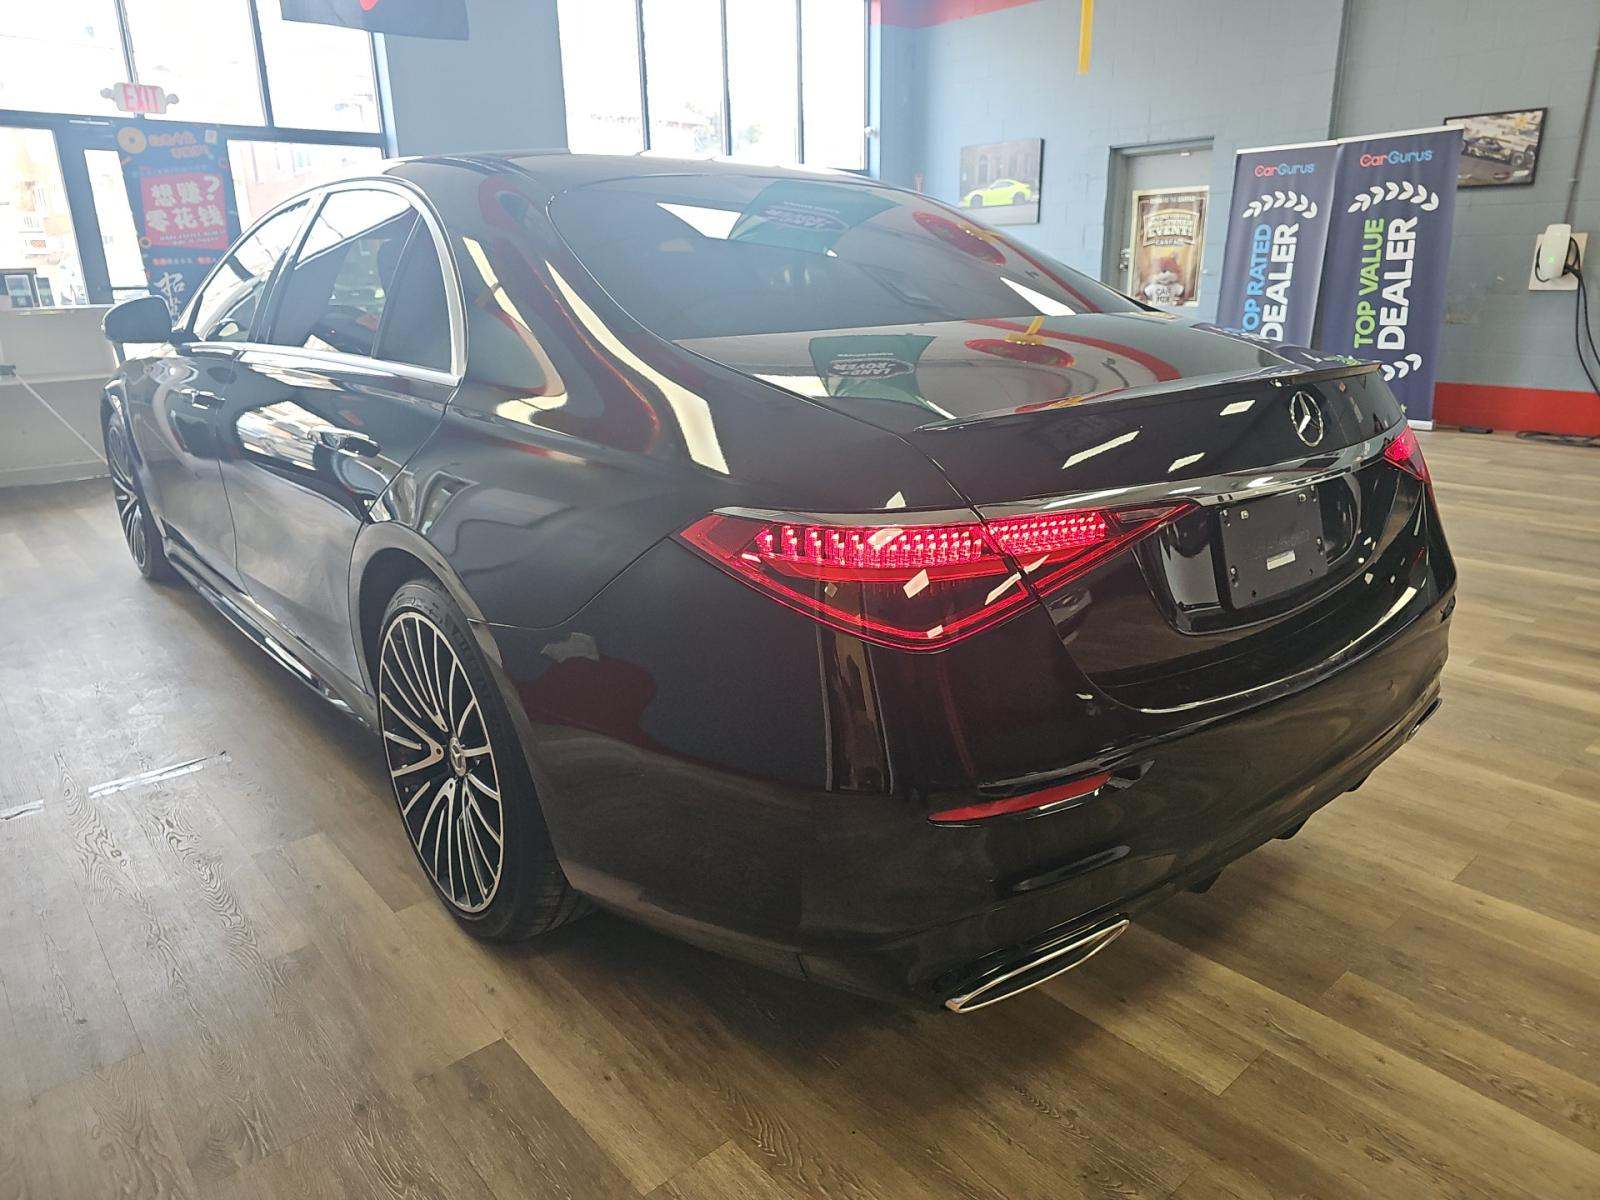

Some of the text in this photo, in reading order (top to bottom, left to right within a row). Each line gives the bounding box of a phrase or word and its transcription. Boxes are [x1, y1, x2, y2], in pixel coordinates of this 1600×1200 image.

[123, 85, 163, 113] EXIT
[1254, 163, 1316, 177] CarGurus
[1359, 150, 1433, 168] CarGurus
[1242, 223, 1272, 331] OP RATED
[1259, 223, 1299, 342] DEALER
[1354, 217, 1385, 349] TOP VALUE
[1377, 216, 1418, 350] DEALER
